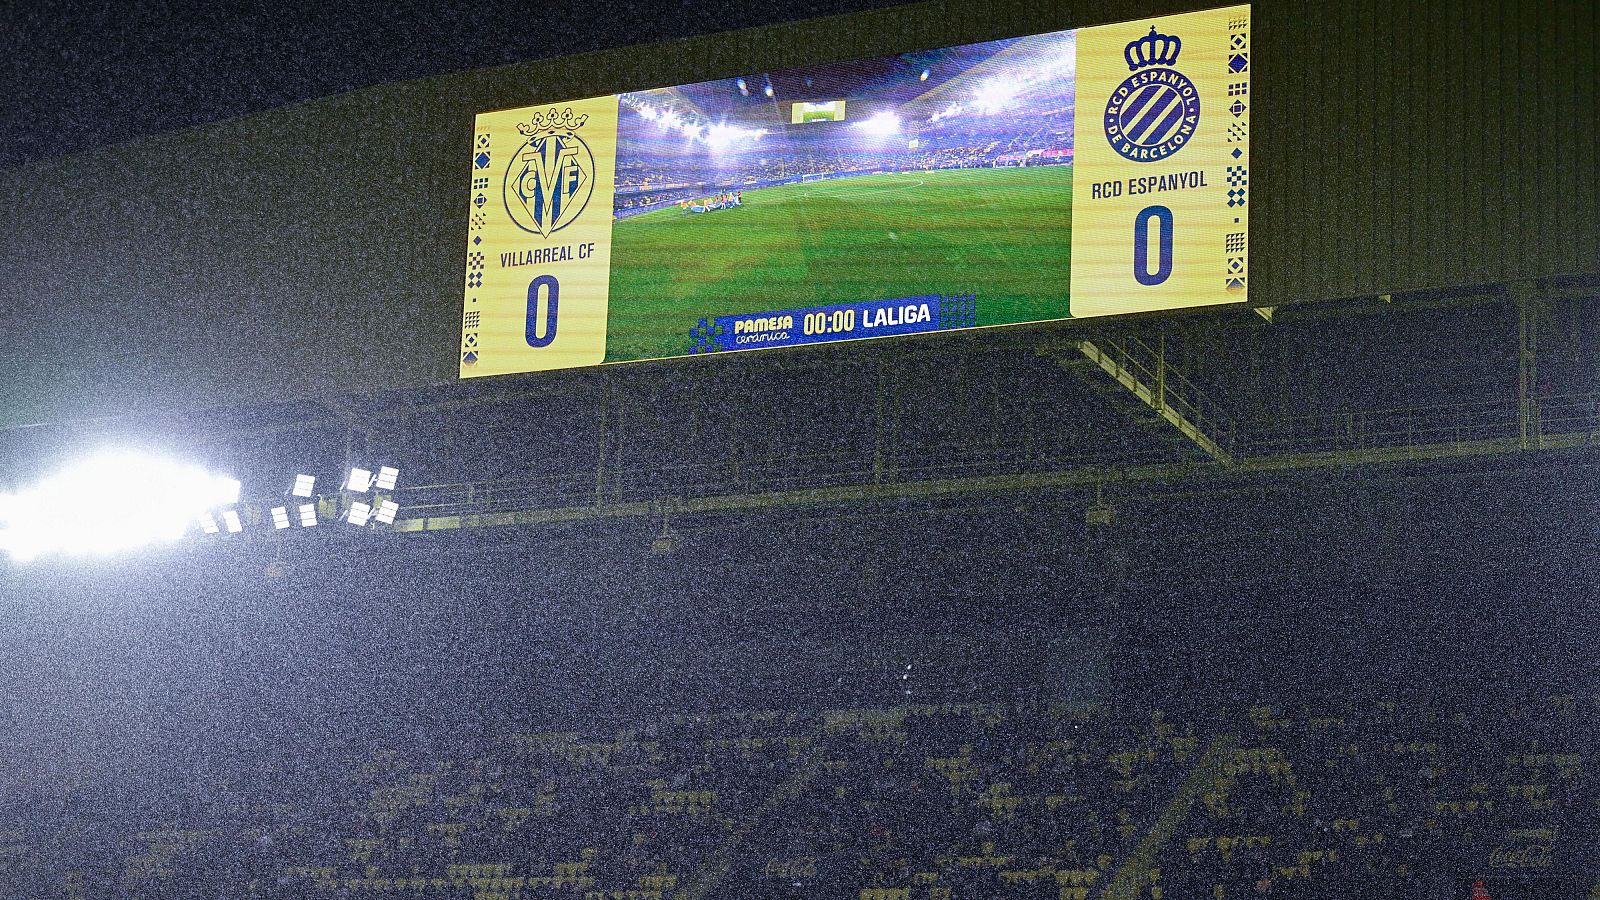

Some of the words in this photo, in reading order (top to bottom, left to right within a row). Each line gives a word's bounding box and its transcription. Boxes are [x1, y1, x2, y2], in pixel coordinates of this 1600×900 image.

[1108, 86, 1128, 114] RCD
[1131, 72, 1196, 105] ESPANYOL
[1108, 125, 1122, 144] DE
[1121, 115, 1196, 159] BARCELONA
[1091, 180, 1122, 199] RCD
[1128, 170, 1208, 195] ESPANYOL
[500, 245, 574, 268] VILLARREAL
[578, 242, 595, 259] CF
[1133, 205, 1174, 286] 0
[525, 274, 559, 348] 0
[734, 315, 793, 335] PAMESA
[803, 309, 855, 335] 00:00
[862, 303, 931, 328] LALIGA
